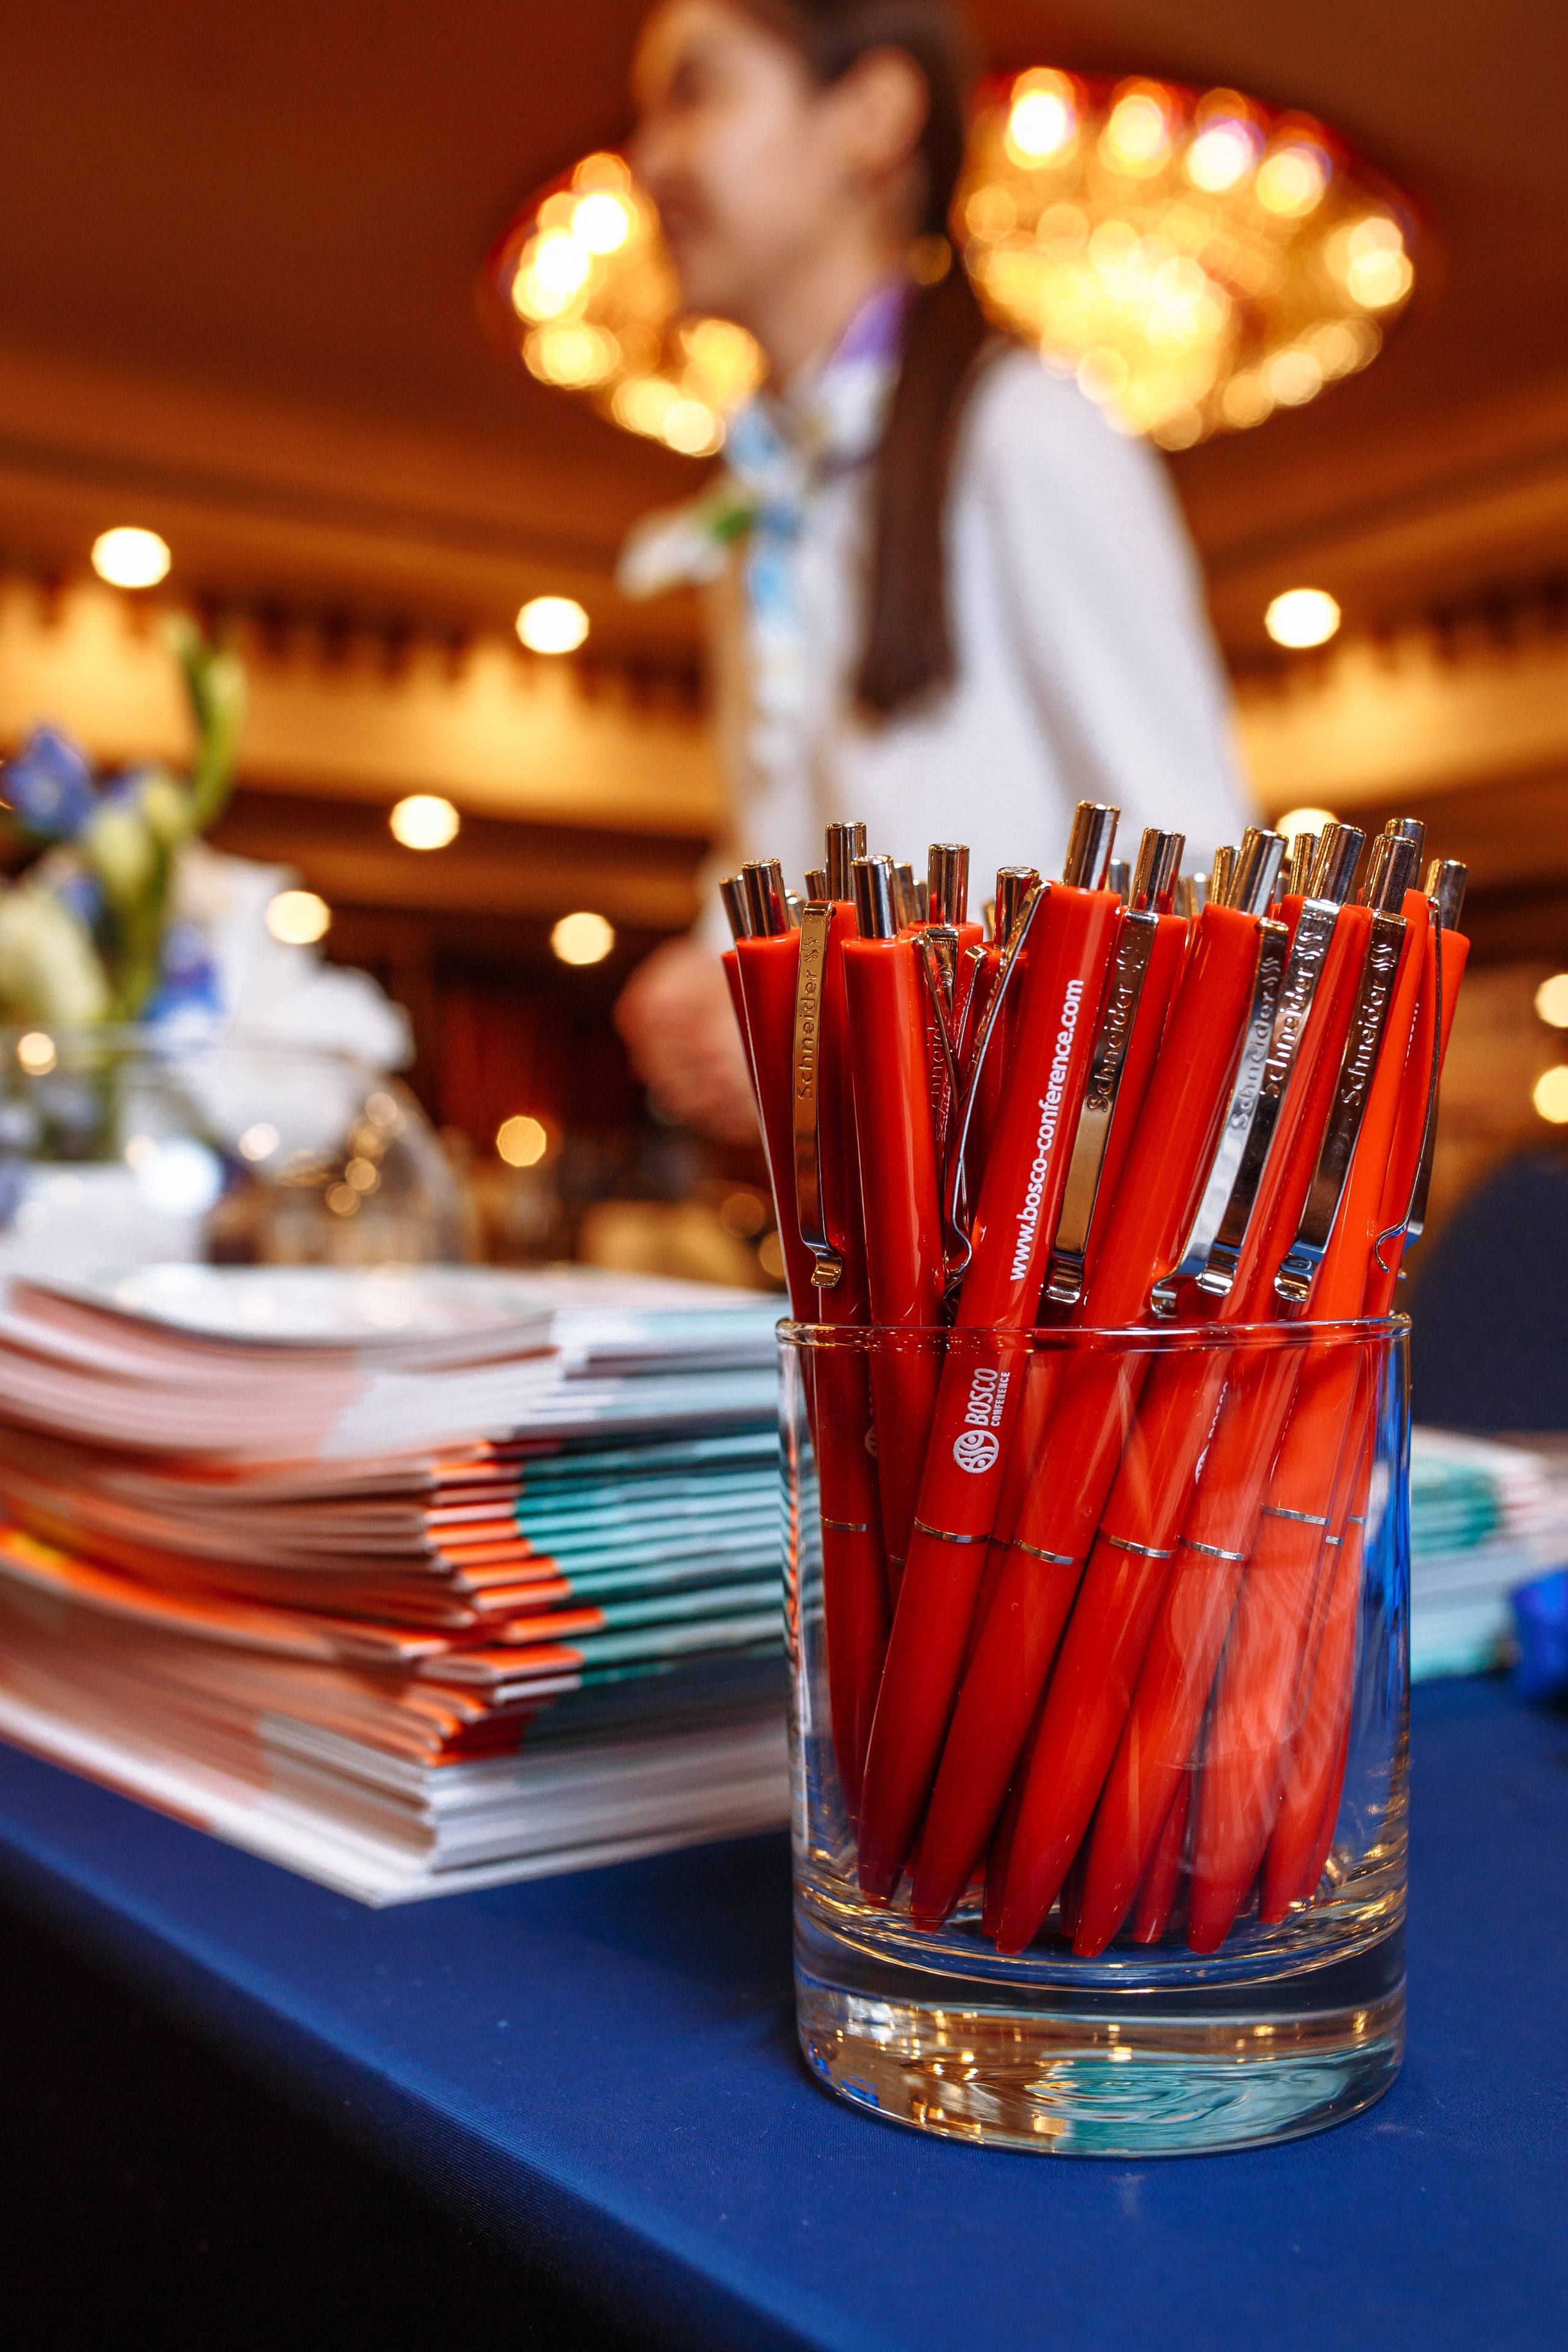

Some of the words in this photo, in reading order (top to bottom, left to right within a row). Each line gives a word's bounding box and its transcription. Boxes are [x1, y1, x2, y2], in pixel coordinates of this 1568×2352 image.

[797, 970, 818, 1100] Schneider
[1087, 983, 1133, 1112] Schneider
[1231, 991, 1274, 1129] Schneider
[1341, 979, 1386, 1106] Schneider
[1009, 979, 1084, 1280] www.bosco-conference.com
[963, 1368, 998, 1427] BOSCO
[990, 1371, 1011, 1427] CONFERENCE
